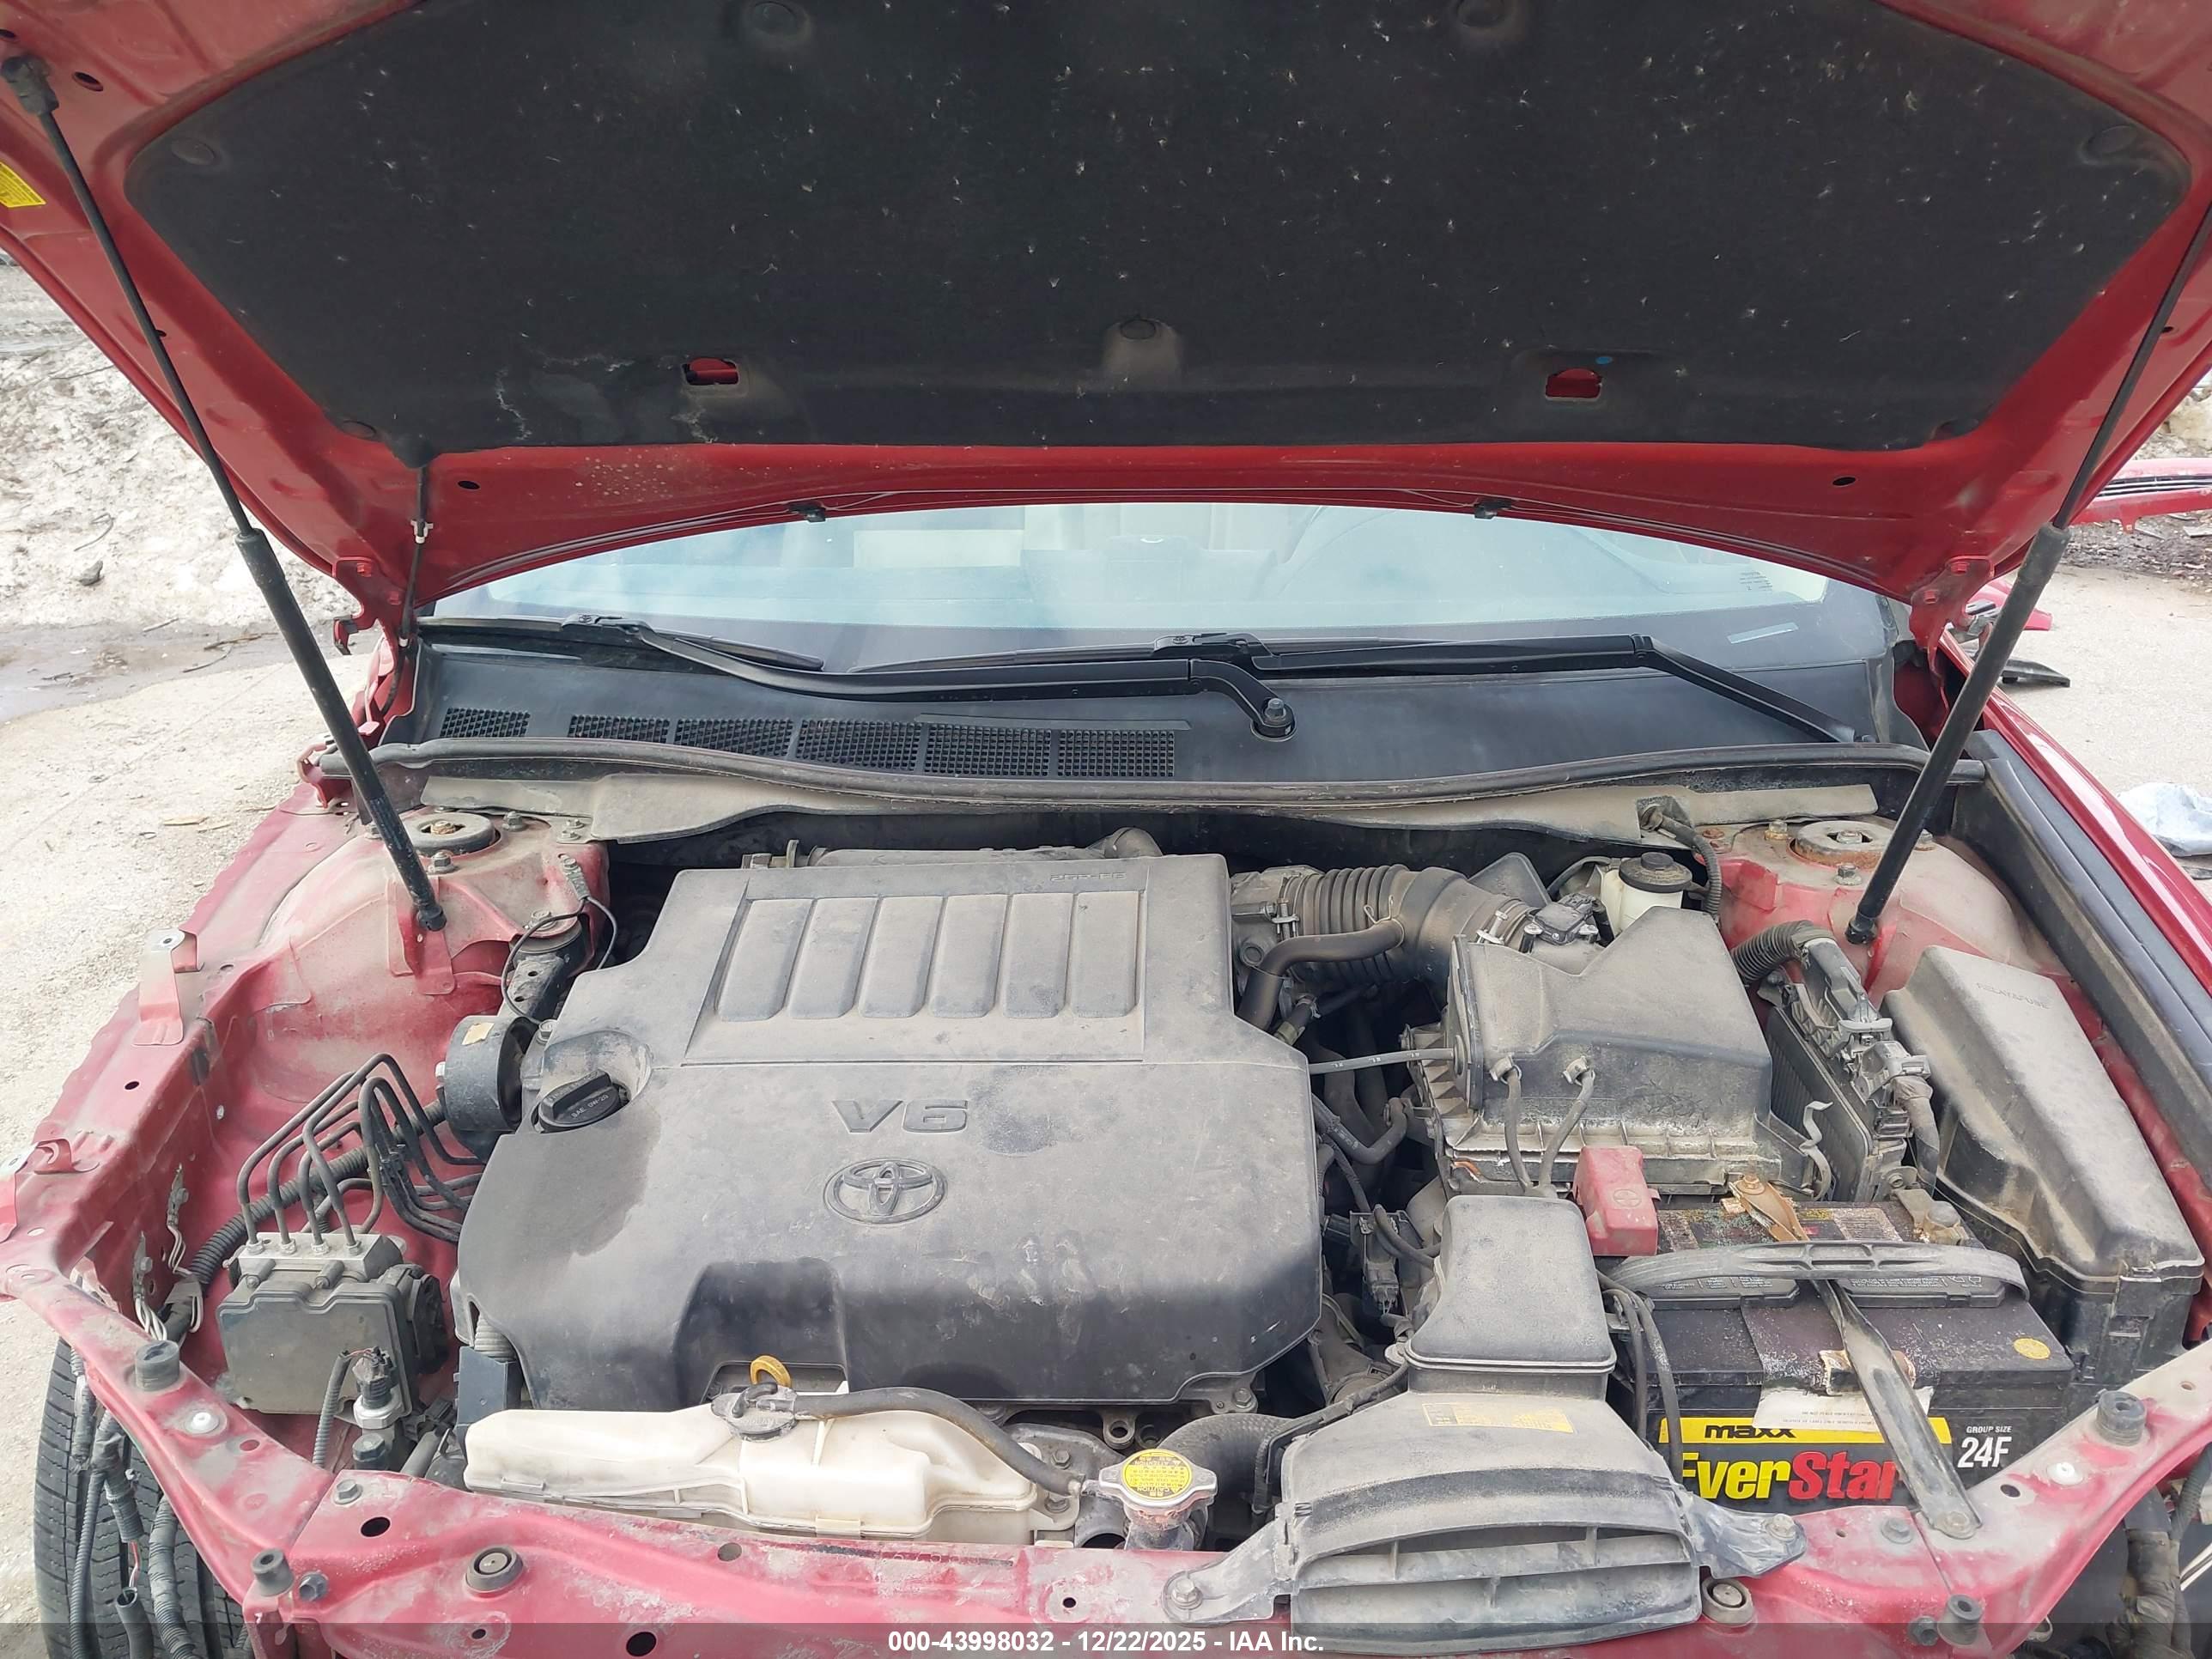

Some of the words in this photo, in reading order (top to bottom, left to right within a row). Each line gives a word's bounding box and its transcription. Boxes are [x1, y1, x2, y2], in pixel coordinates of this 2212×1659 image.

[570, 1106, 586, 1118] SAE
[831, 1098, 969, 1133] V6
[1705, 1425, 1797, 1439] maxx
[1966, 1425, 1994, 1434] GROUP
[1957, 1436, 2013, 1468] 24F
